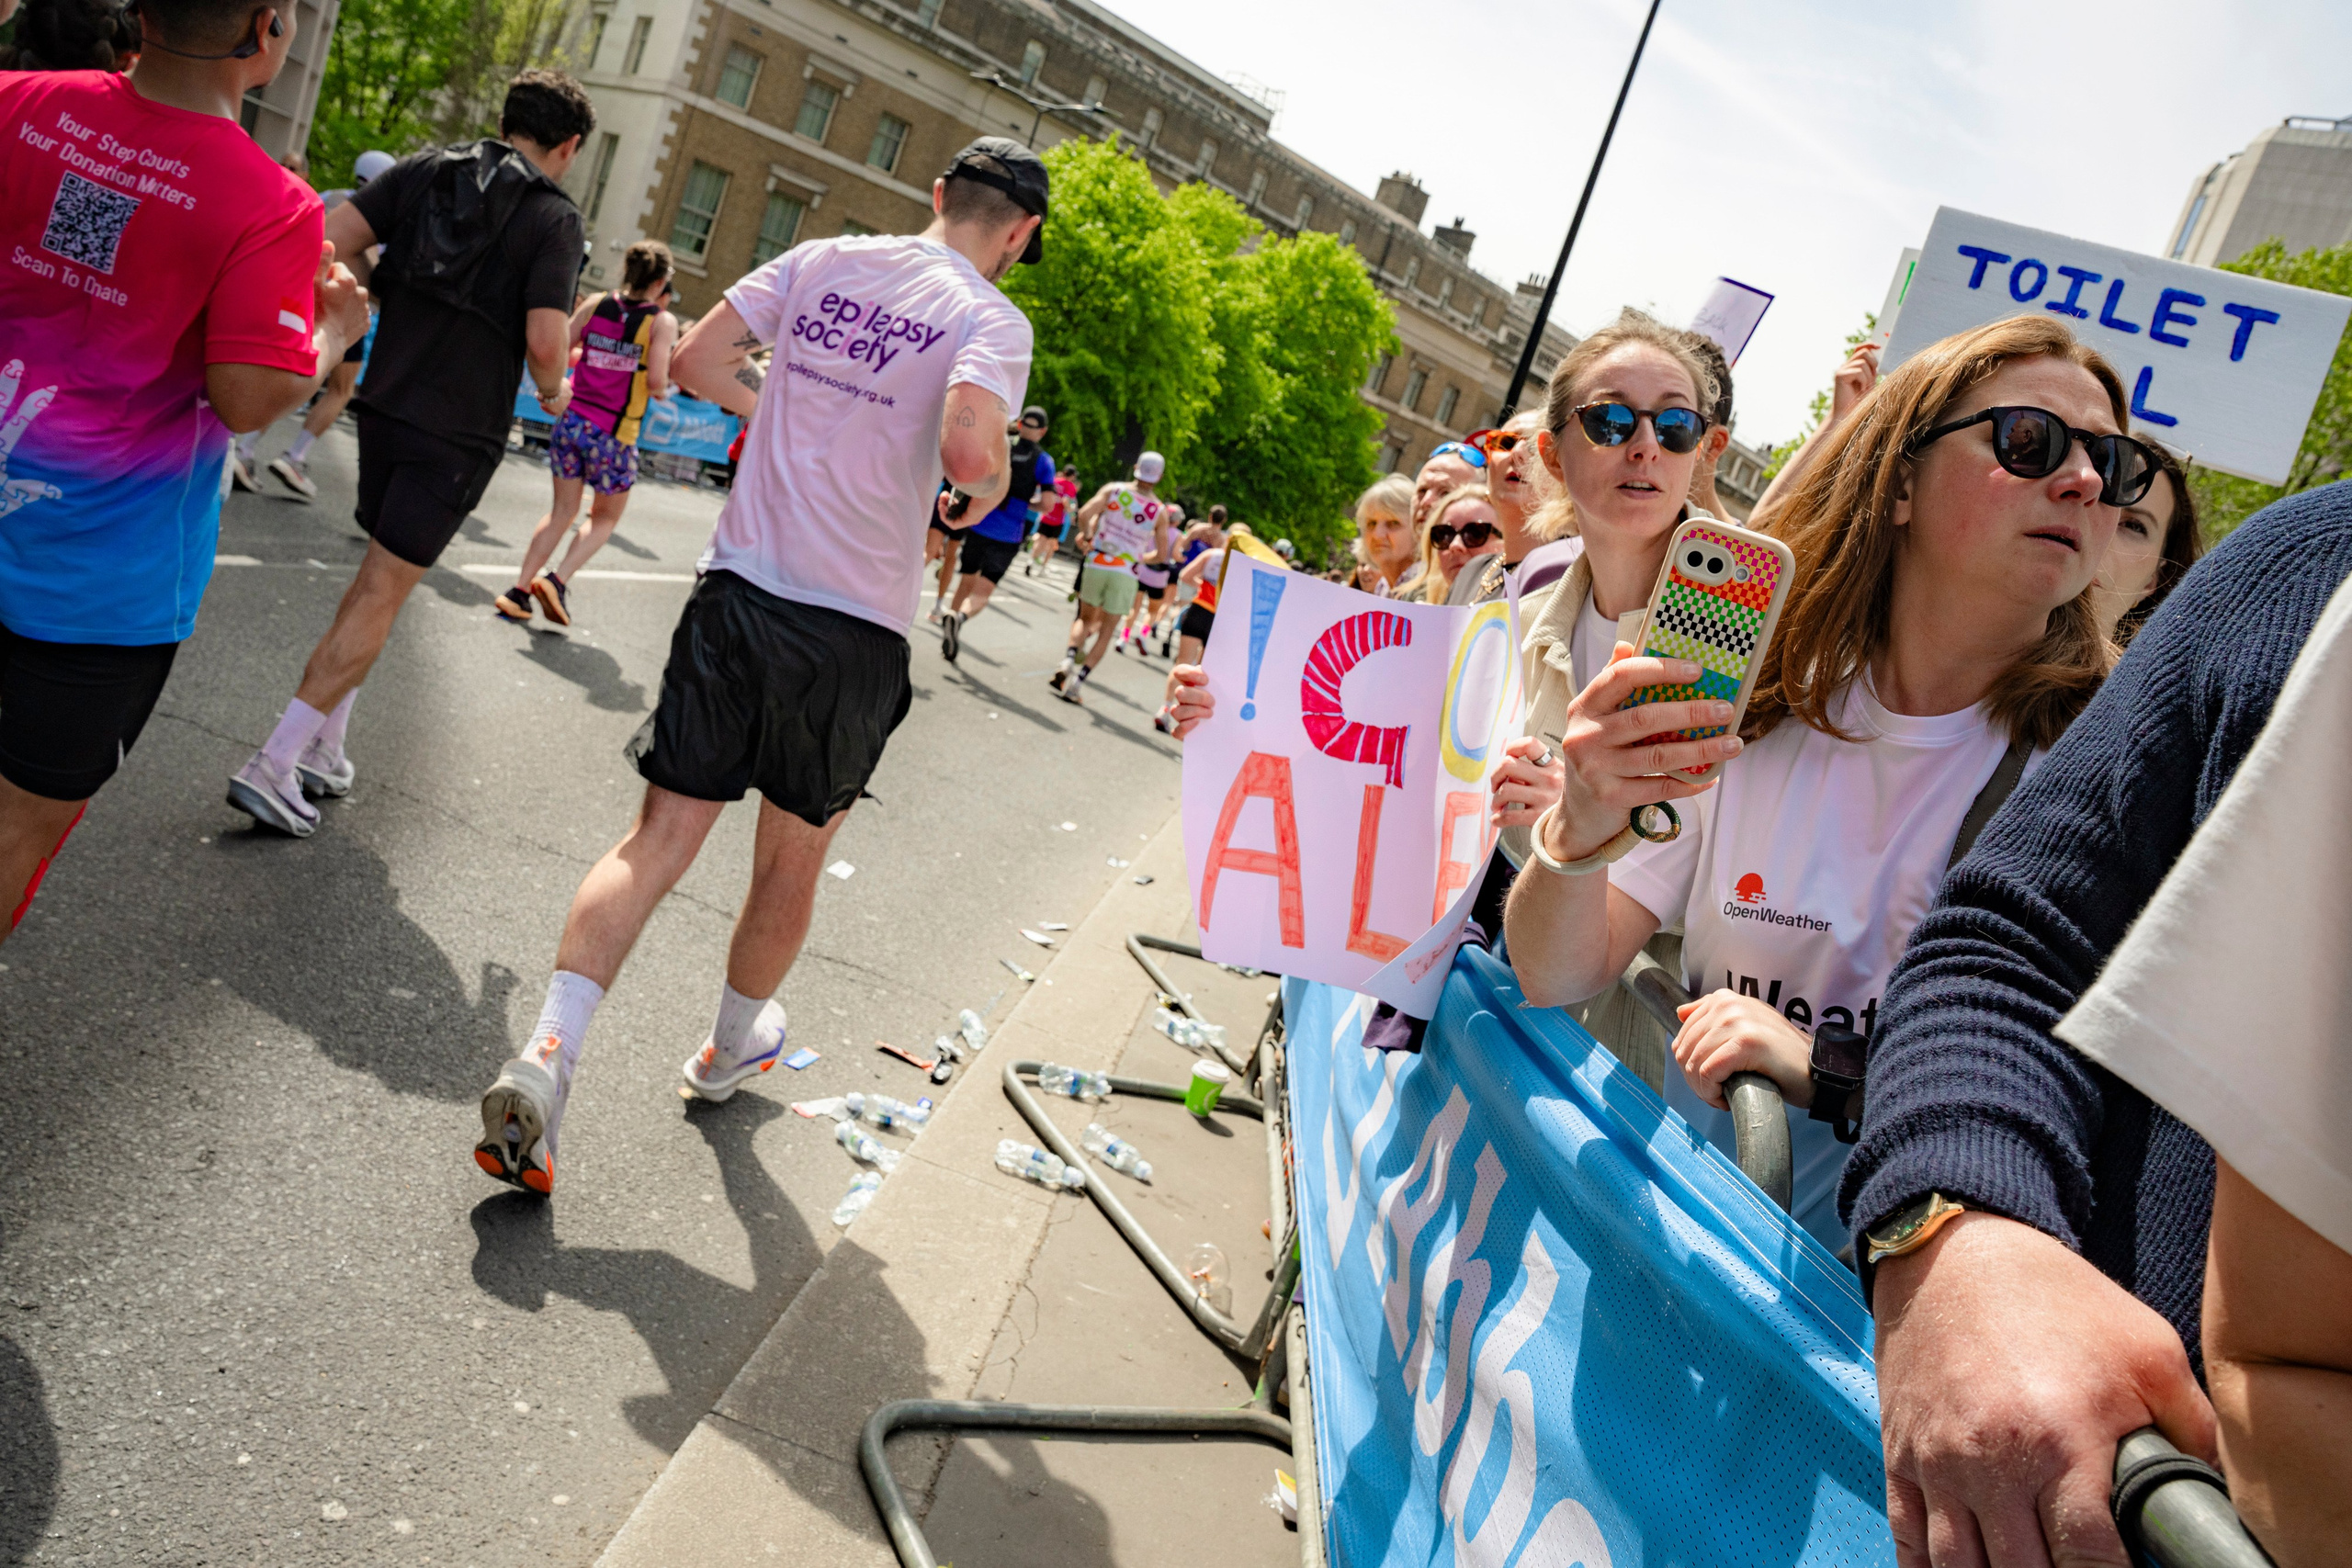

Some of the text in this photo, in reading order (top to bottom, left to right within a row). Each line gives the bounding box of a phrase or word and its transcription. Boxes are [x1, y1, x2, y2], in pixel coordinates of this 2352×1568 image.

[17, 121, 198, 211] Your Donation Mtters
[55, 110, 96, 141] Your
[96, 133, 138, 164] Step
[11, 244, 129, 308] Scan To Dnate
[1958, 244, 2281, 362] TOILET
[791, 314, 900, 374] society
[820, 292, 946, 355] epilepsy
[2130, 365, 2180, 428] L
[1199, 750, 1501, 964] ALE
[1723, 901, 1833, 932] OpenWeather
